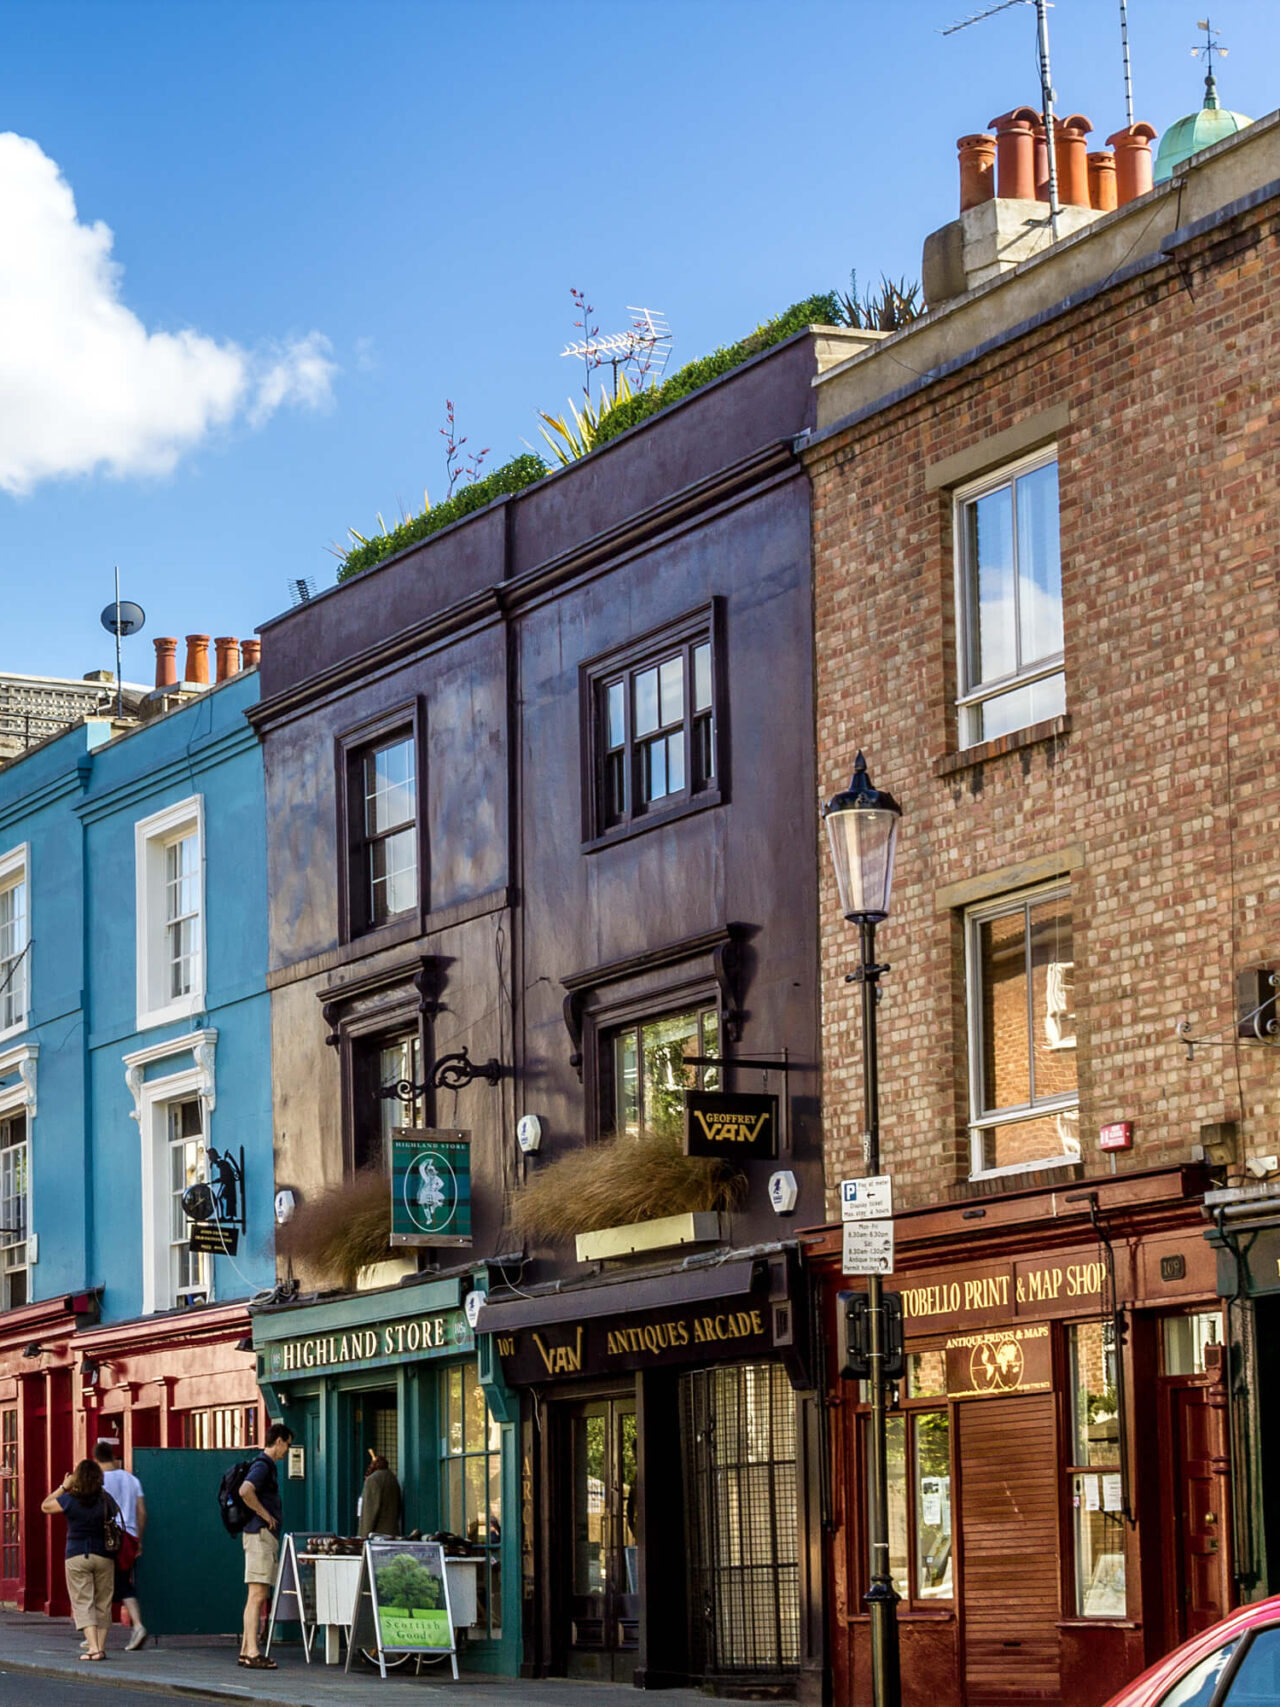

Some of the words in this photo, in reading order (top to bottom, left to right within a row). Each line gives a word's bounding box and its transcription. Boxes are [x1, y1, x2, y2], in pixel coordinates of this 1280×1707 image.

[694, 1110, 769, 1142] VAN
[706, 1113, 756, 1124] GEOFFREY
[964, 1275, 1010, 1311] PRINT
[1016, 1276, 1025, 1303] &
[1028, 1268, 1063, 1302] MAP
[1066, 1262, 1107, 1297] SHOP
[283, 1331, 378, 1370] HIGHLAND
[384, 1318, 445, 1355] STORE
[607, 1321, 690, 1356] ANTIQUES
[694, 1310, 765, 1344] ARCADE
[945, 1337, 984, 1349] ANTIQUE
[1015, 1330, 1023, 1340] &
[1024, 1326, 1049, 1339] MAPS
[497, 1338, 516, 1357] 107
[532, 1326, 584, 1375] VAN
[385, 1618, 440, 1630] Scottish
[396, 1630, 432, 1640] Goods
